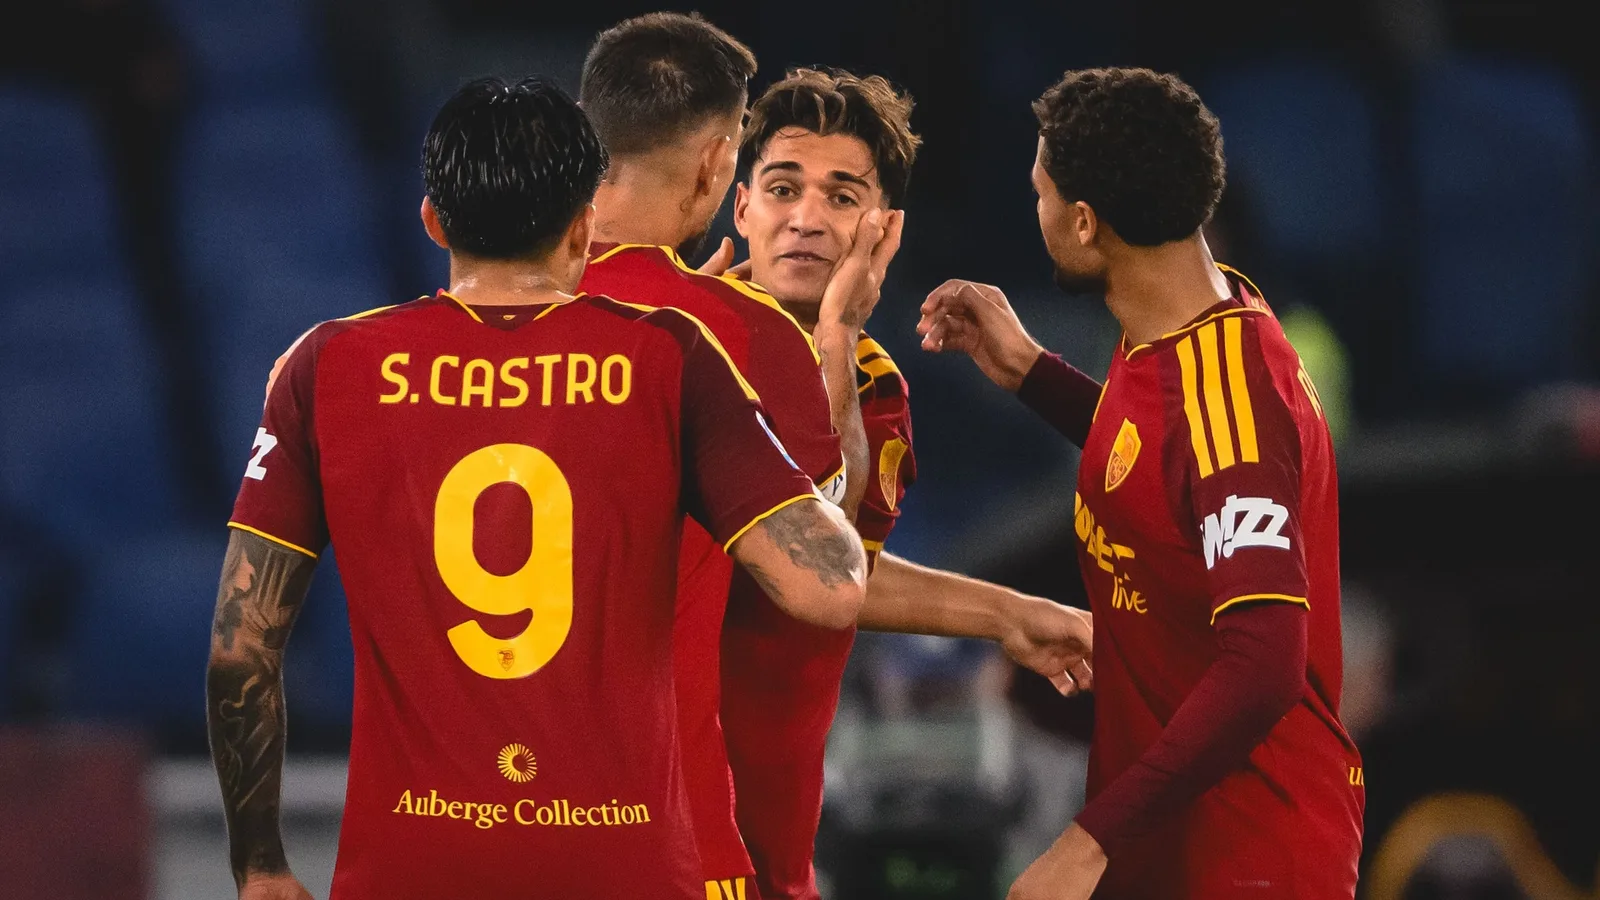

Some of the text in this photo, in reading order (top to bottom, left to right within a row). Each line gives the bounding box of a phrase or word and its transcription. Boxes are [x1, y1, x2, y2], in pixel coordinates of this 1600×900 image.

[379, 352, 632, 408] S.CASTRO
[433, 442, 574, 680] 9
[392, 789, 651, 829] Auberge Collection
